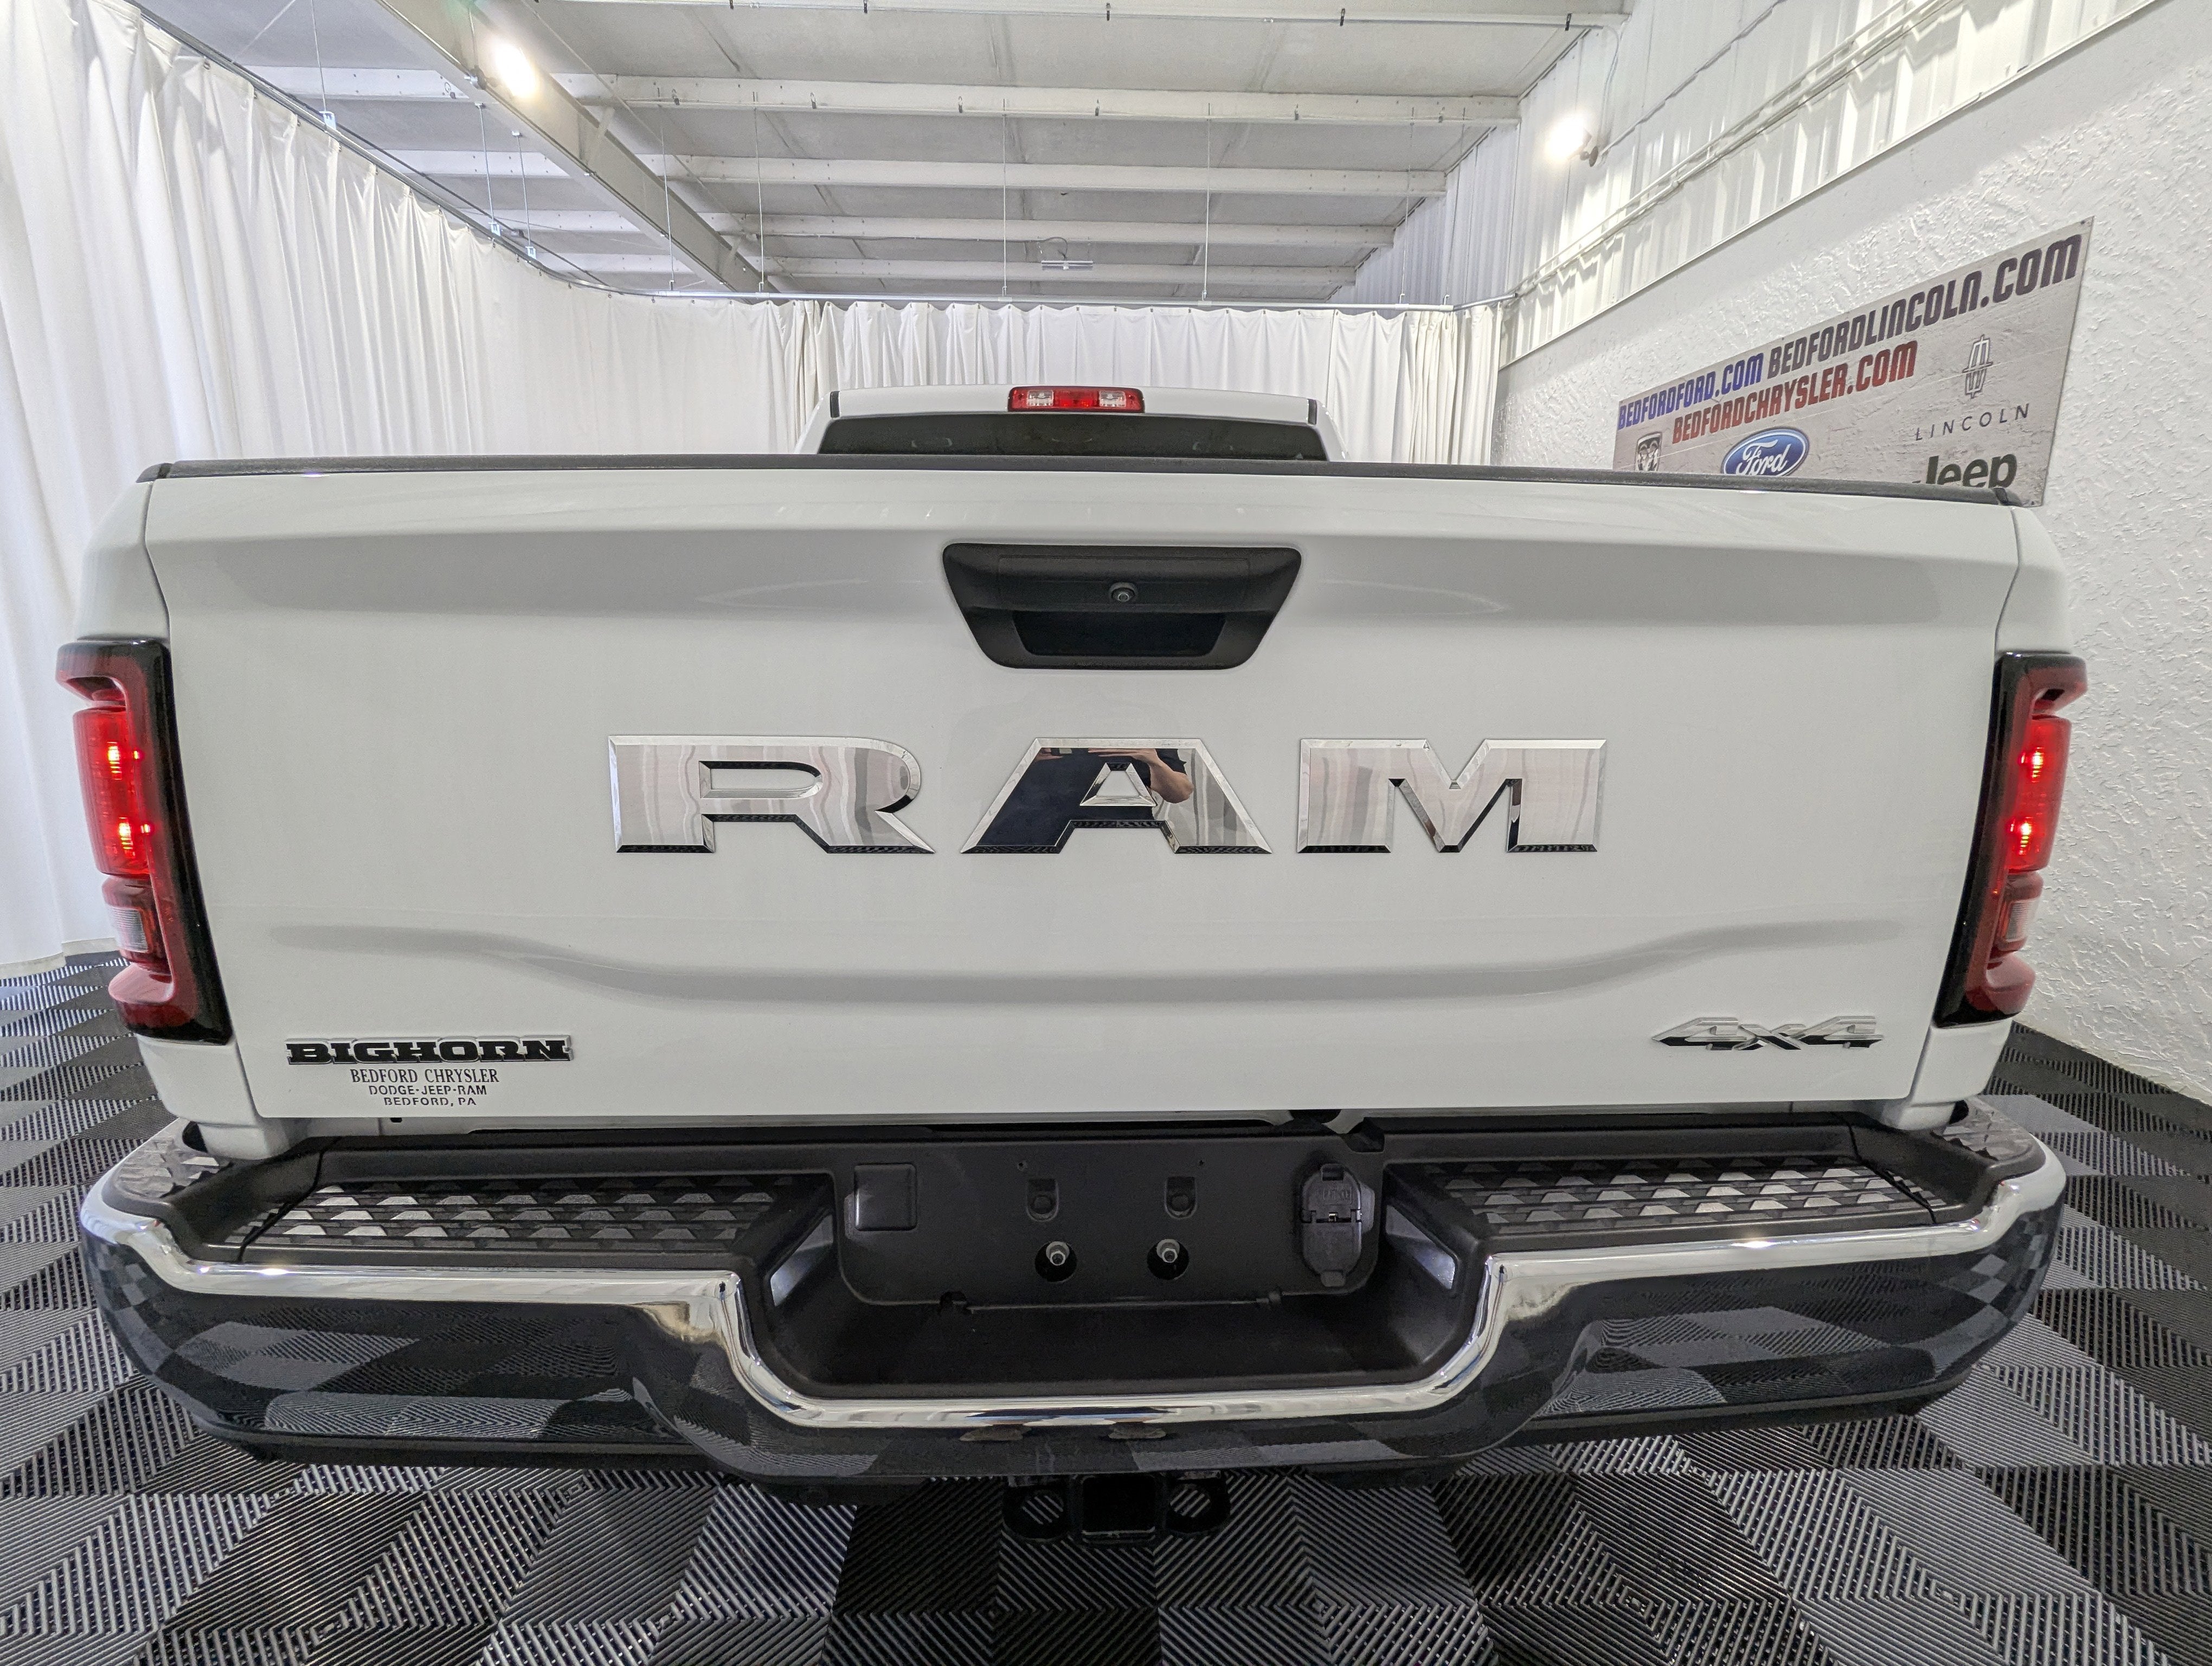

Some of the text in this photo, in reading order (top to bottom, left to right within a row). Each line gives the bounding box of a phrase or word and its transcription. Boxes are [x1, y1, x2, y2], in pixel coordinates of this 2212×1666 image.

[1618, 234, 2082, 430] BEDFORDFORD.COM BEDFORDLINCOLN.COM
[1672, 340, 1918, 444] BEDFORDCHRYSLER.COM
[1915, 403, 2030, 441] LINCOLN
[1735, 439, 1791, 476] Ford
[1912, 453, 2017, 488] Jeep
[608, 735, 1606, 853] RAM
[350, 1068, 499, 1084] BEDFORD CHRYSLER
[383, 1097, 477, 1107] BEDFORD, PA
